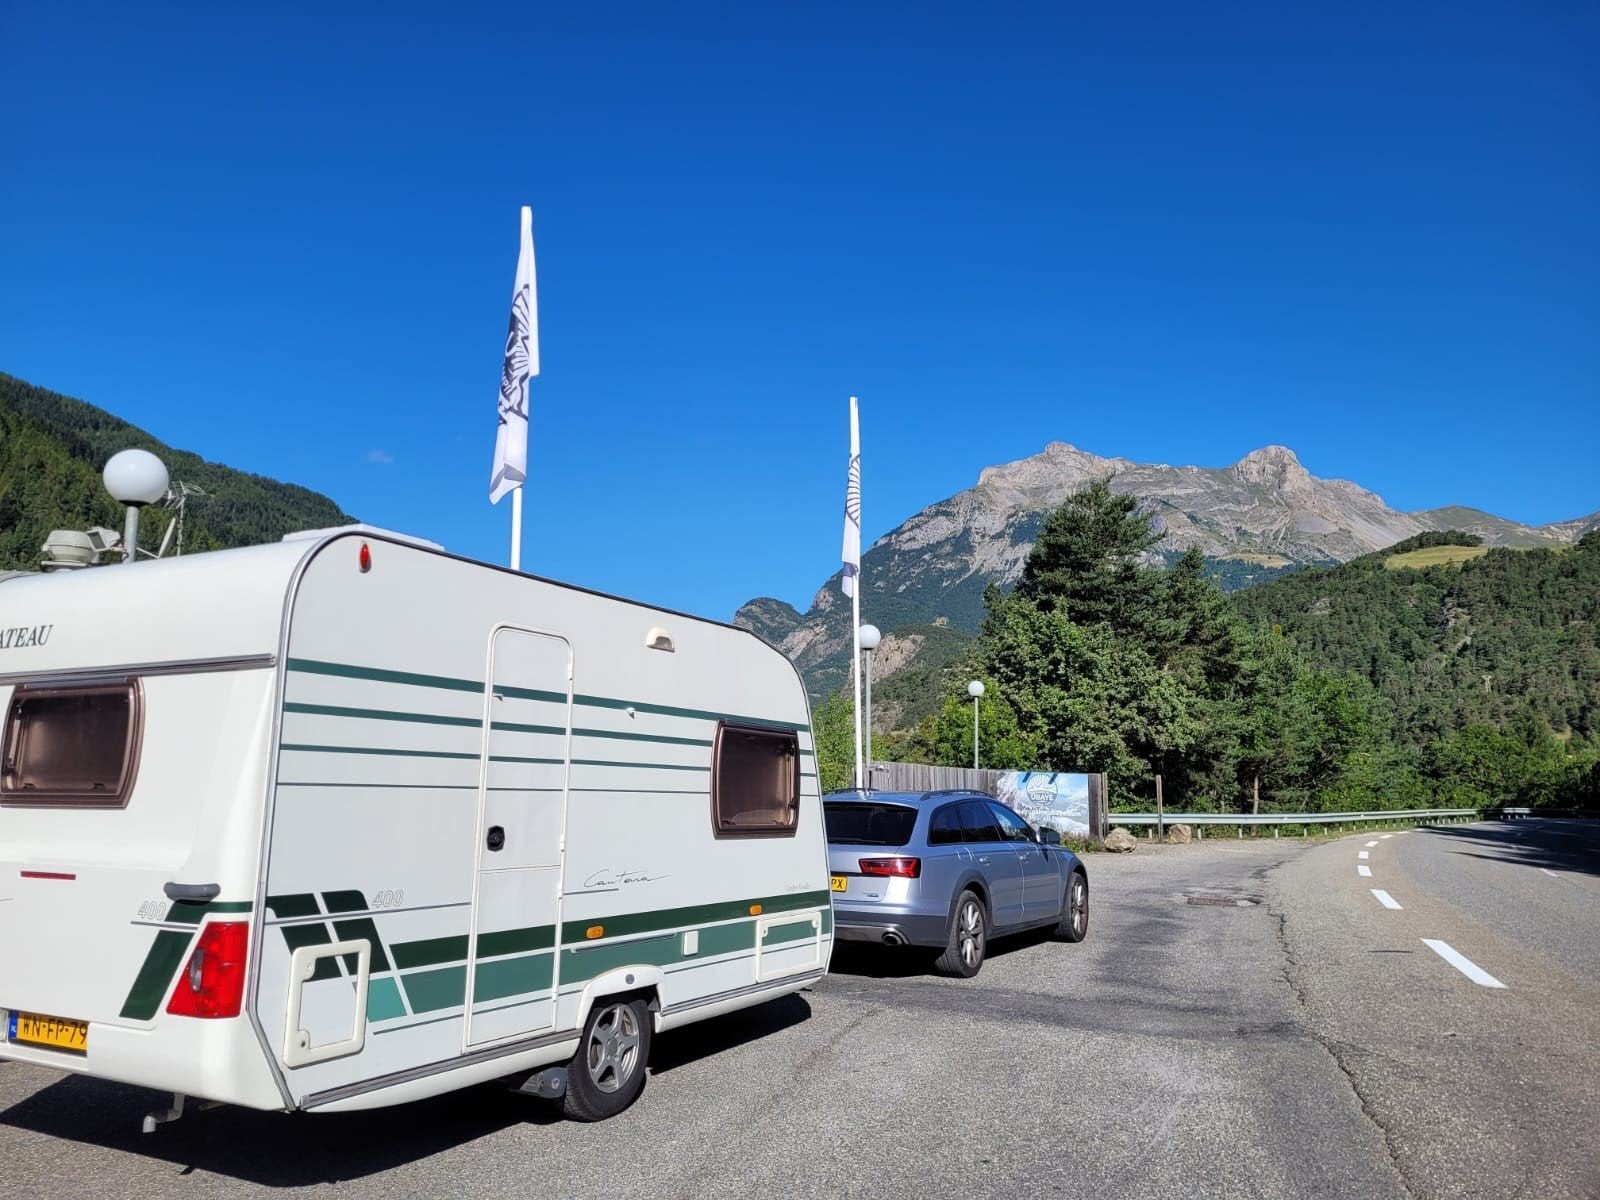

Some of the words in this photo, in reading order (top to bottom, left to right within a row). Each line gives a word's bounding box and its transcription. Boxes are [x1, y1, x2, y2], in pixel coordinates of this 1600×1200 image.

[1031, 792, 1054, 801] UBAYE
[371, 889, 404, 909] 400
[137, 900, 167, 920] 400
